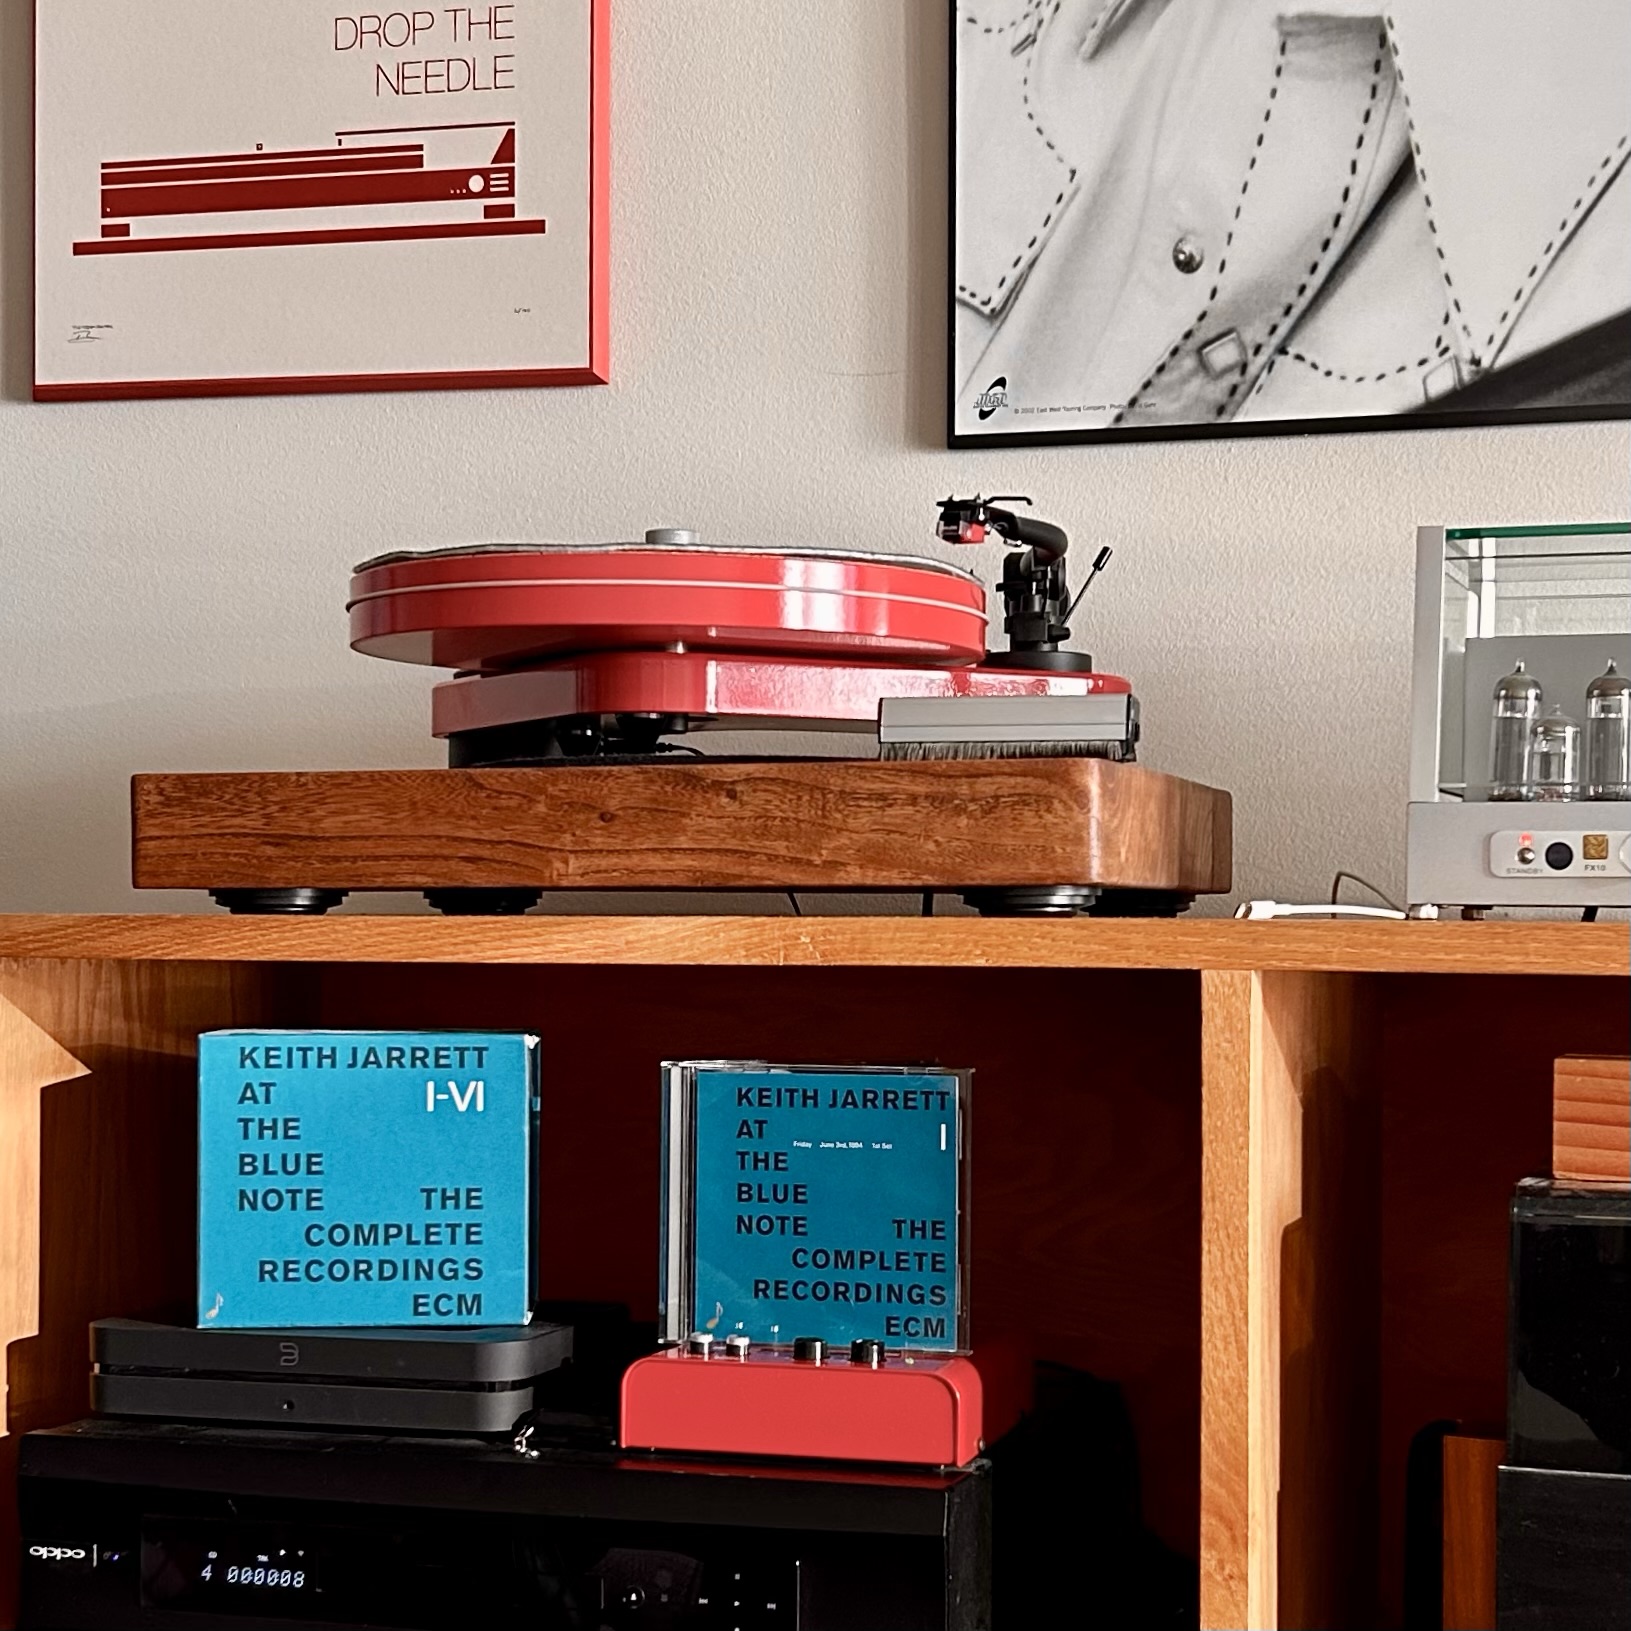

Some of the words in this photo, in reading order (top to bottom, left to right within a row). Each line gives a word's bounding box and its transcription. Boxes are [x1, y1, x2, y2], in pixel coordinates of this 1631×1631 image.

[335, 11, 435, 51] DROP
[444, 5, 515, 42] THE
[376, 54, 515, 97] NEEDLE
[1584, 864, 1606, 872] FX10
[239, 1046, 338, 1069] KEITH
[347, 1046, 489, 1069] JARRETT
[237, 1082, 277, 1104] AT
[426, 1081, 484, 1112] I-VI
[737, 1087, 819, 1109] KEITH
[828, 1089, 950, 1111] JARRETT
[237, 1117, 301, 1140] THE
[736, 1119, 768, 1139] AT
[238, 1153, 325, 1176] BLUE
[737, 1151, 788, 1171] THE
[238, 1188, 324, 1211] NOTE
[420, 1187, 484, 1210] THE
[737, 1183, 808, 1204] BLUE
[304, 1222, 484, 1246] COMPLETE
[737, 1215, 808, 1236] NOTE
[892, 1218, 946, 1241] THE
[258, 1257, 484, 1283] RECORDINGS
[792, 1248, 946, 1273] COMPLETE
[412, 1293, 483, 1316] ECM
[753, 1280, 946, 1306] RECORDINGS
[886, 1316, 945, 1338] ECM
[29, 1546, 86, 1560] oppo
[201, 1564, 212, 1581] 4
[227, 1566, 305, 1588] 000008
